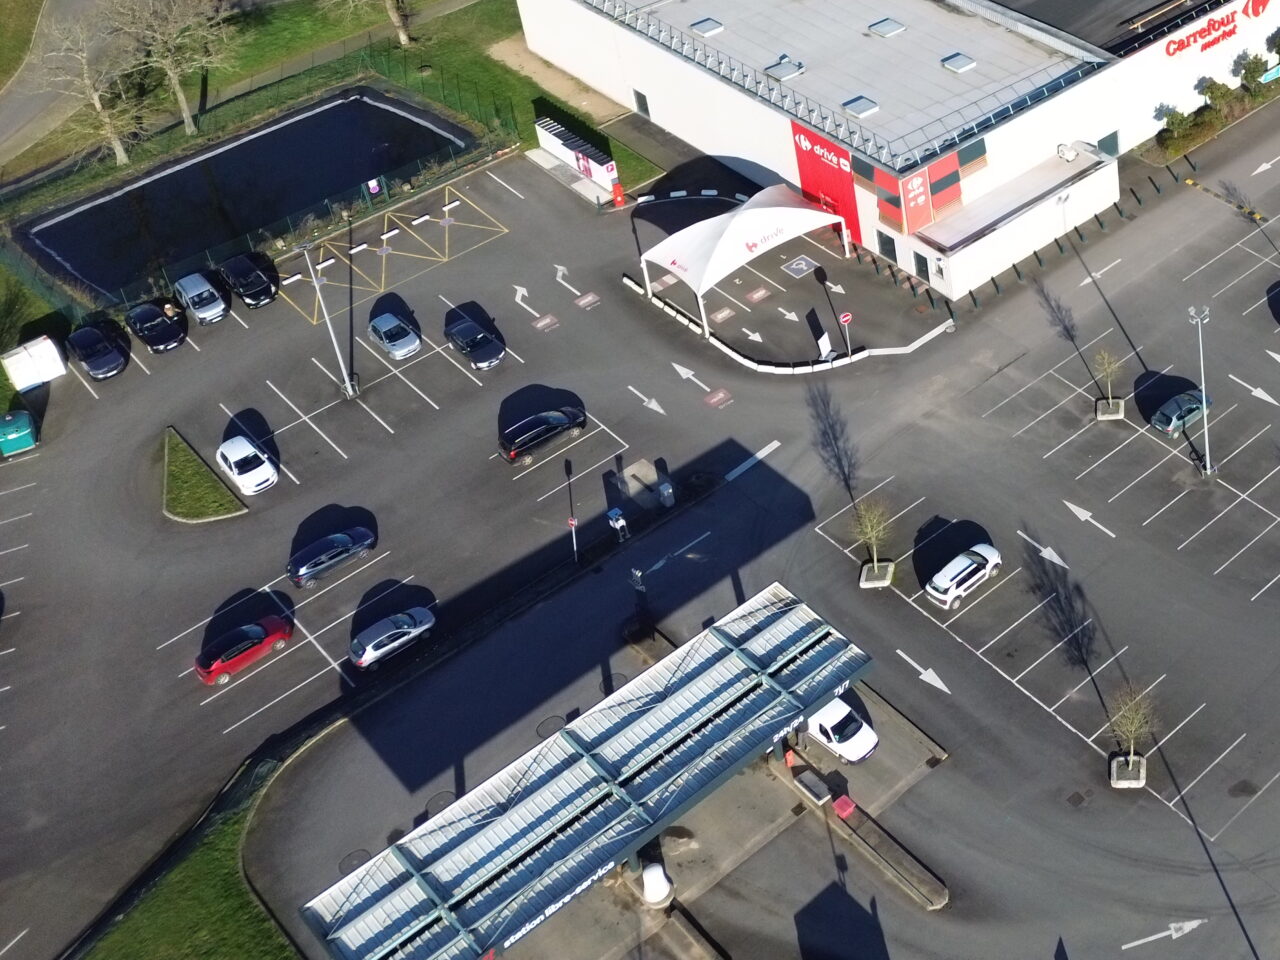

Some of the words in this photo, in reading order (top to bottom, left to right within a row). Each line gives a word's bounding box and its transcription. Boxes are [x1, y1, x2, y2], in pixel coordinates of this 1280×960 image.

[1165, 10, 1238, 57] Carrefour
[1200, 24, 1238, 52] market
[814, 144, 838, 163] drive
[503, 914, 545, 949] station
[544, 861, 615, 918] libre-service
